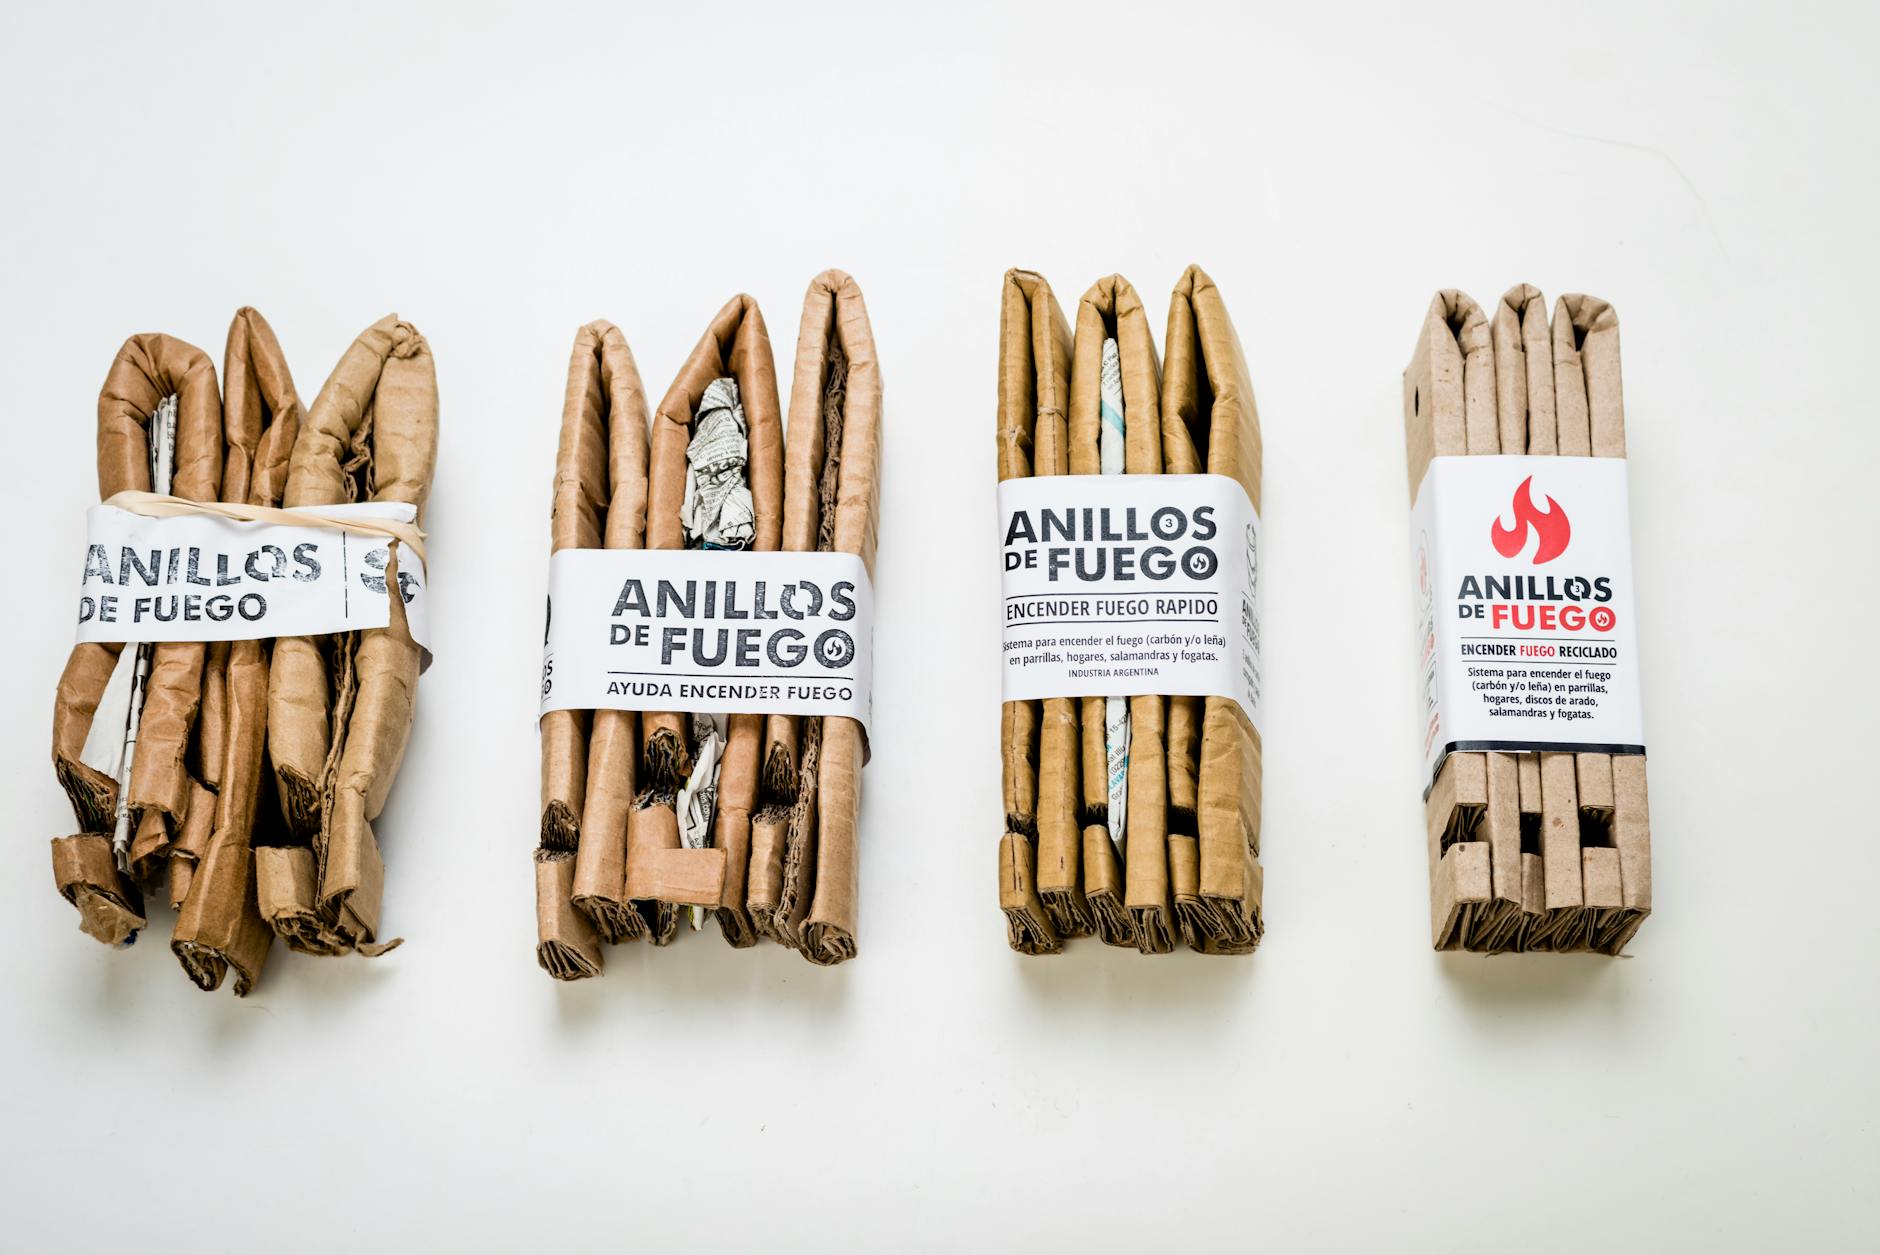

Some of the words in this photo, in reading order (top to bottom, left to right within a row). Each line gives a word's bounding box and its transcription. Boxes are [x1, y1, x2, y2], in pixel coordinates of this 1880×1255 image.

[1004, 506, 1216, 546] ANILLOS
[82, 543, 321, 586] ANILLOS
[1004, 549, 1038, 572] DE
[1049, 546, 1218, 581] FUEGO
[1457, 575, 1613, 603] ANILLOS
[78, 595, 119, 625] DE
[134, 593, 266, 623] FUEGO
[611, 579, 856, 621] ANILLOS
[1006, 600, 1090, 621] ENCENDER
[1096, 599, 1150, 616] FUEGO
[1156, 599, 1218, 615] RAPIDO
[1458, 604, 1485, 619] DE
[1491, 604, 1617, 633] FUEGO
[609, 623, 650, 647] DE
[661, 627, 855, 669] FUEGO
[1035, 638, 1057, 651] para
[1059, 635, 1103, 647] encender
[1105, 635, 1114, 646] el
[1116, 635, 1144, 648] fuego
[1146, 633, 1182, 647] (carbón
[1184, 634, 1202, 648] y/o
[1203, 634, 1226, 649] leña)
[1461, 644, 1517, 656] ENCENDER
[1519, 644, 1556, 657] FUEGO
[1559, 645, 1618, 659] RECICLADO
[1009, 656, 1021, 666] en
[1023, 651, 1064, 667] parrillas,
[1066, 651, 1107, 665] hogares,
[1109, 649, 1170, 662] salamandras
[1172, 652, 1179, 664] y
[1180, 649, 1219, 664] fogatas.
[1068, 668, 1112, 678] INDUSTRIA
[1113, 667, 1159, 677] ARGENTINA
[1467, 667, 1504, 678] Sistema
[1506, 670, 1528, 680] para
[1529, 668, 1572, 679] encender
[1574, 669, 1583, 680] el
[1584, 669, 1611, 682] fuego
[606, 681, 673, 697] AYUDA
[679, 684, 780, 700] ENCENDER
[787, 686, 853, 701] FUEGO
[1471, 680, 1508, 692] (carbón
[1509, 681, 1526, 693] y/o
[1528, 681, 1552, 693] leña)
[1554, 684, 1566, 692] en
[1568, 682, 1608, 695] parrillas,
[1483, 693, 1523, 706] hogares,
[1525, 694, 1553, 705] discos
[1555, 695, 1567, 706] de
[1568, 696, 1599, 708] arado,
[1489, 706, 1548, 718] salamandras
[1549, 710, 1556, 721] y
[1557, 708, 1595, 721] fogatas.
